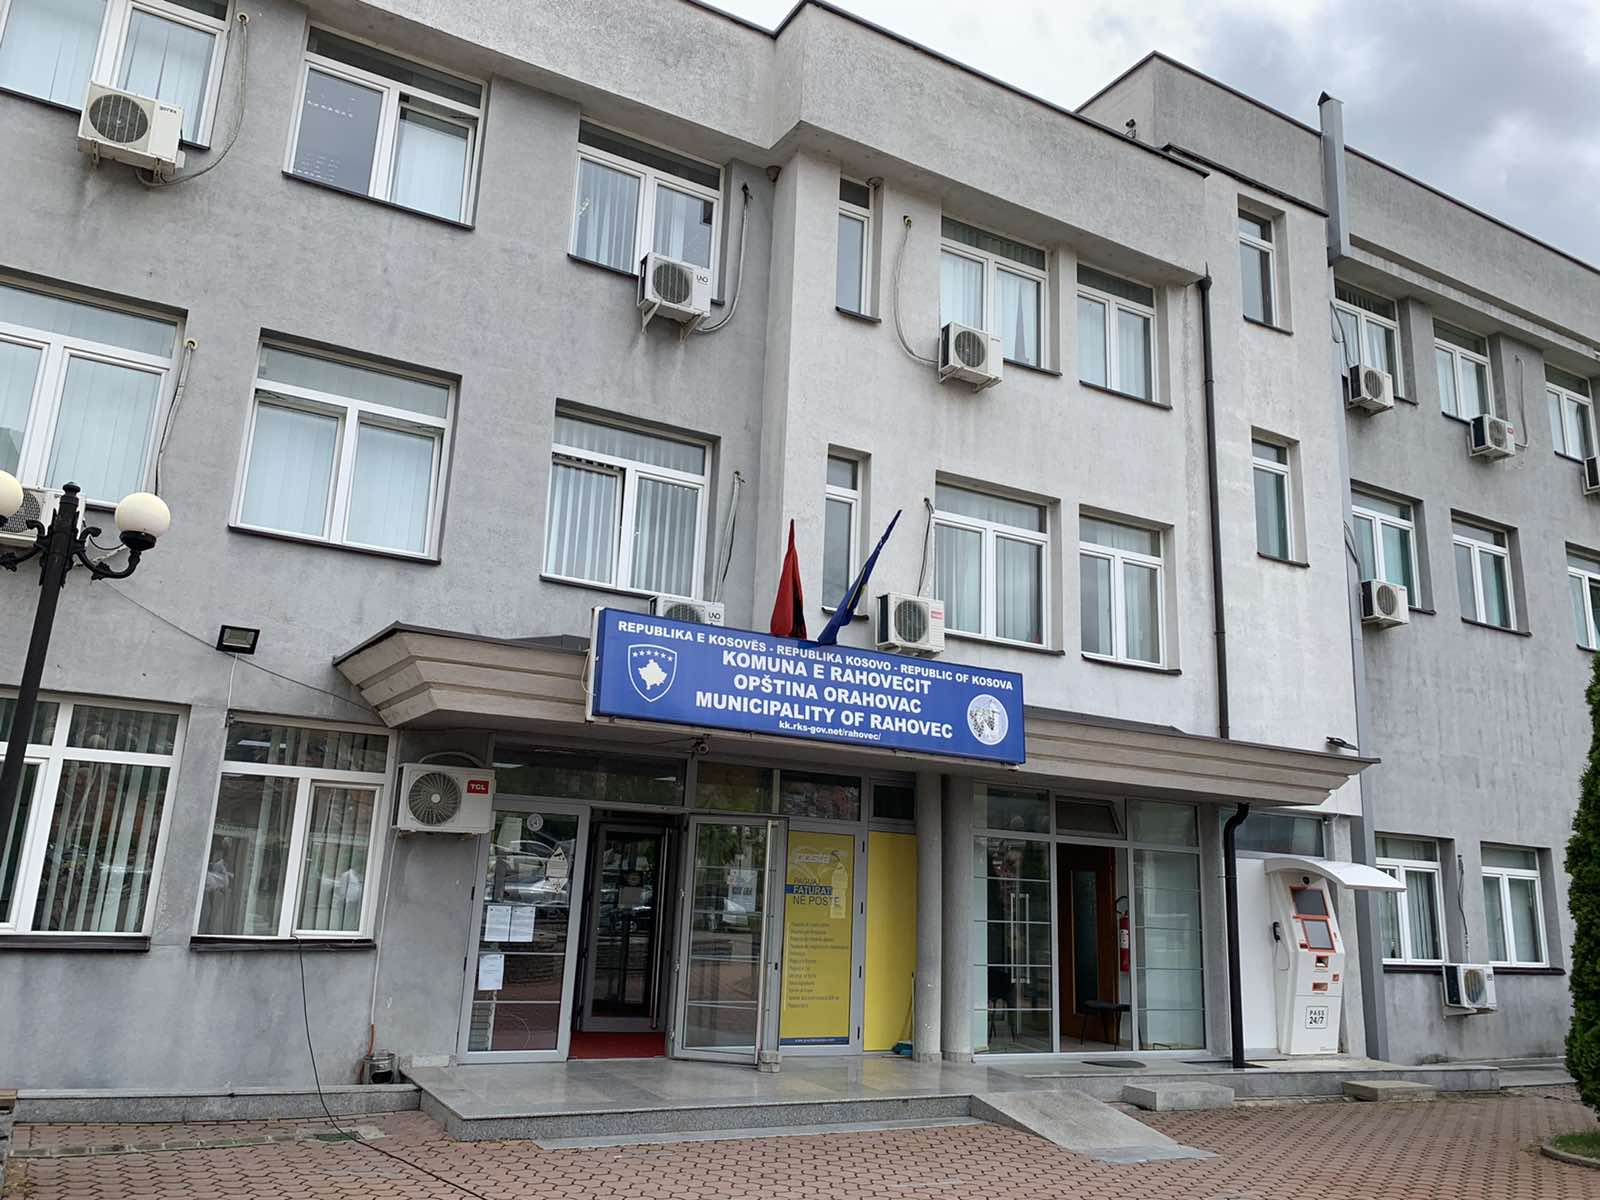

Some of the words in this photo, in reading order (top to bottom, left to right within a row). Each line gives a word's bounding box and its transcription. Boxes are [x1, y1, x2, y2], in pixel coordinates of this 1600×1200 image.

[618, 620, 693, 642] REPUBLIKA
[697, 632, 705, 643] E
[776, 645, 842, 665] REPUBLIKA
[845, 656, 891, 672] KOSOVO
[900, 663, 953, 682] REPUBLIC
[955, 673, 969, 683] OF
[971, 676, 1014, 692] KOSOVA
[722, 650, 809, 678] KOMUNA
[813, 664, 825, 680] E
[830, 666, 932, 695] RAHOVECIT
[695, 691, 836, 724] MUNICIPALITY
[840, 709, 865, 727] OF
[870, 713, 953, 739] RAHOVEC
[733, 673, 819, 701] OPŠTINA
[823, 687, 922, 714] ORAHOVAC
[778, 720, 882, 742] kk.rks-gov.net/rahovec/
[1309, 1016, 1324, 1025] 24/7
